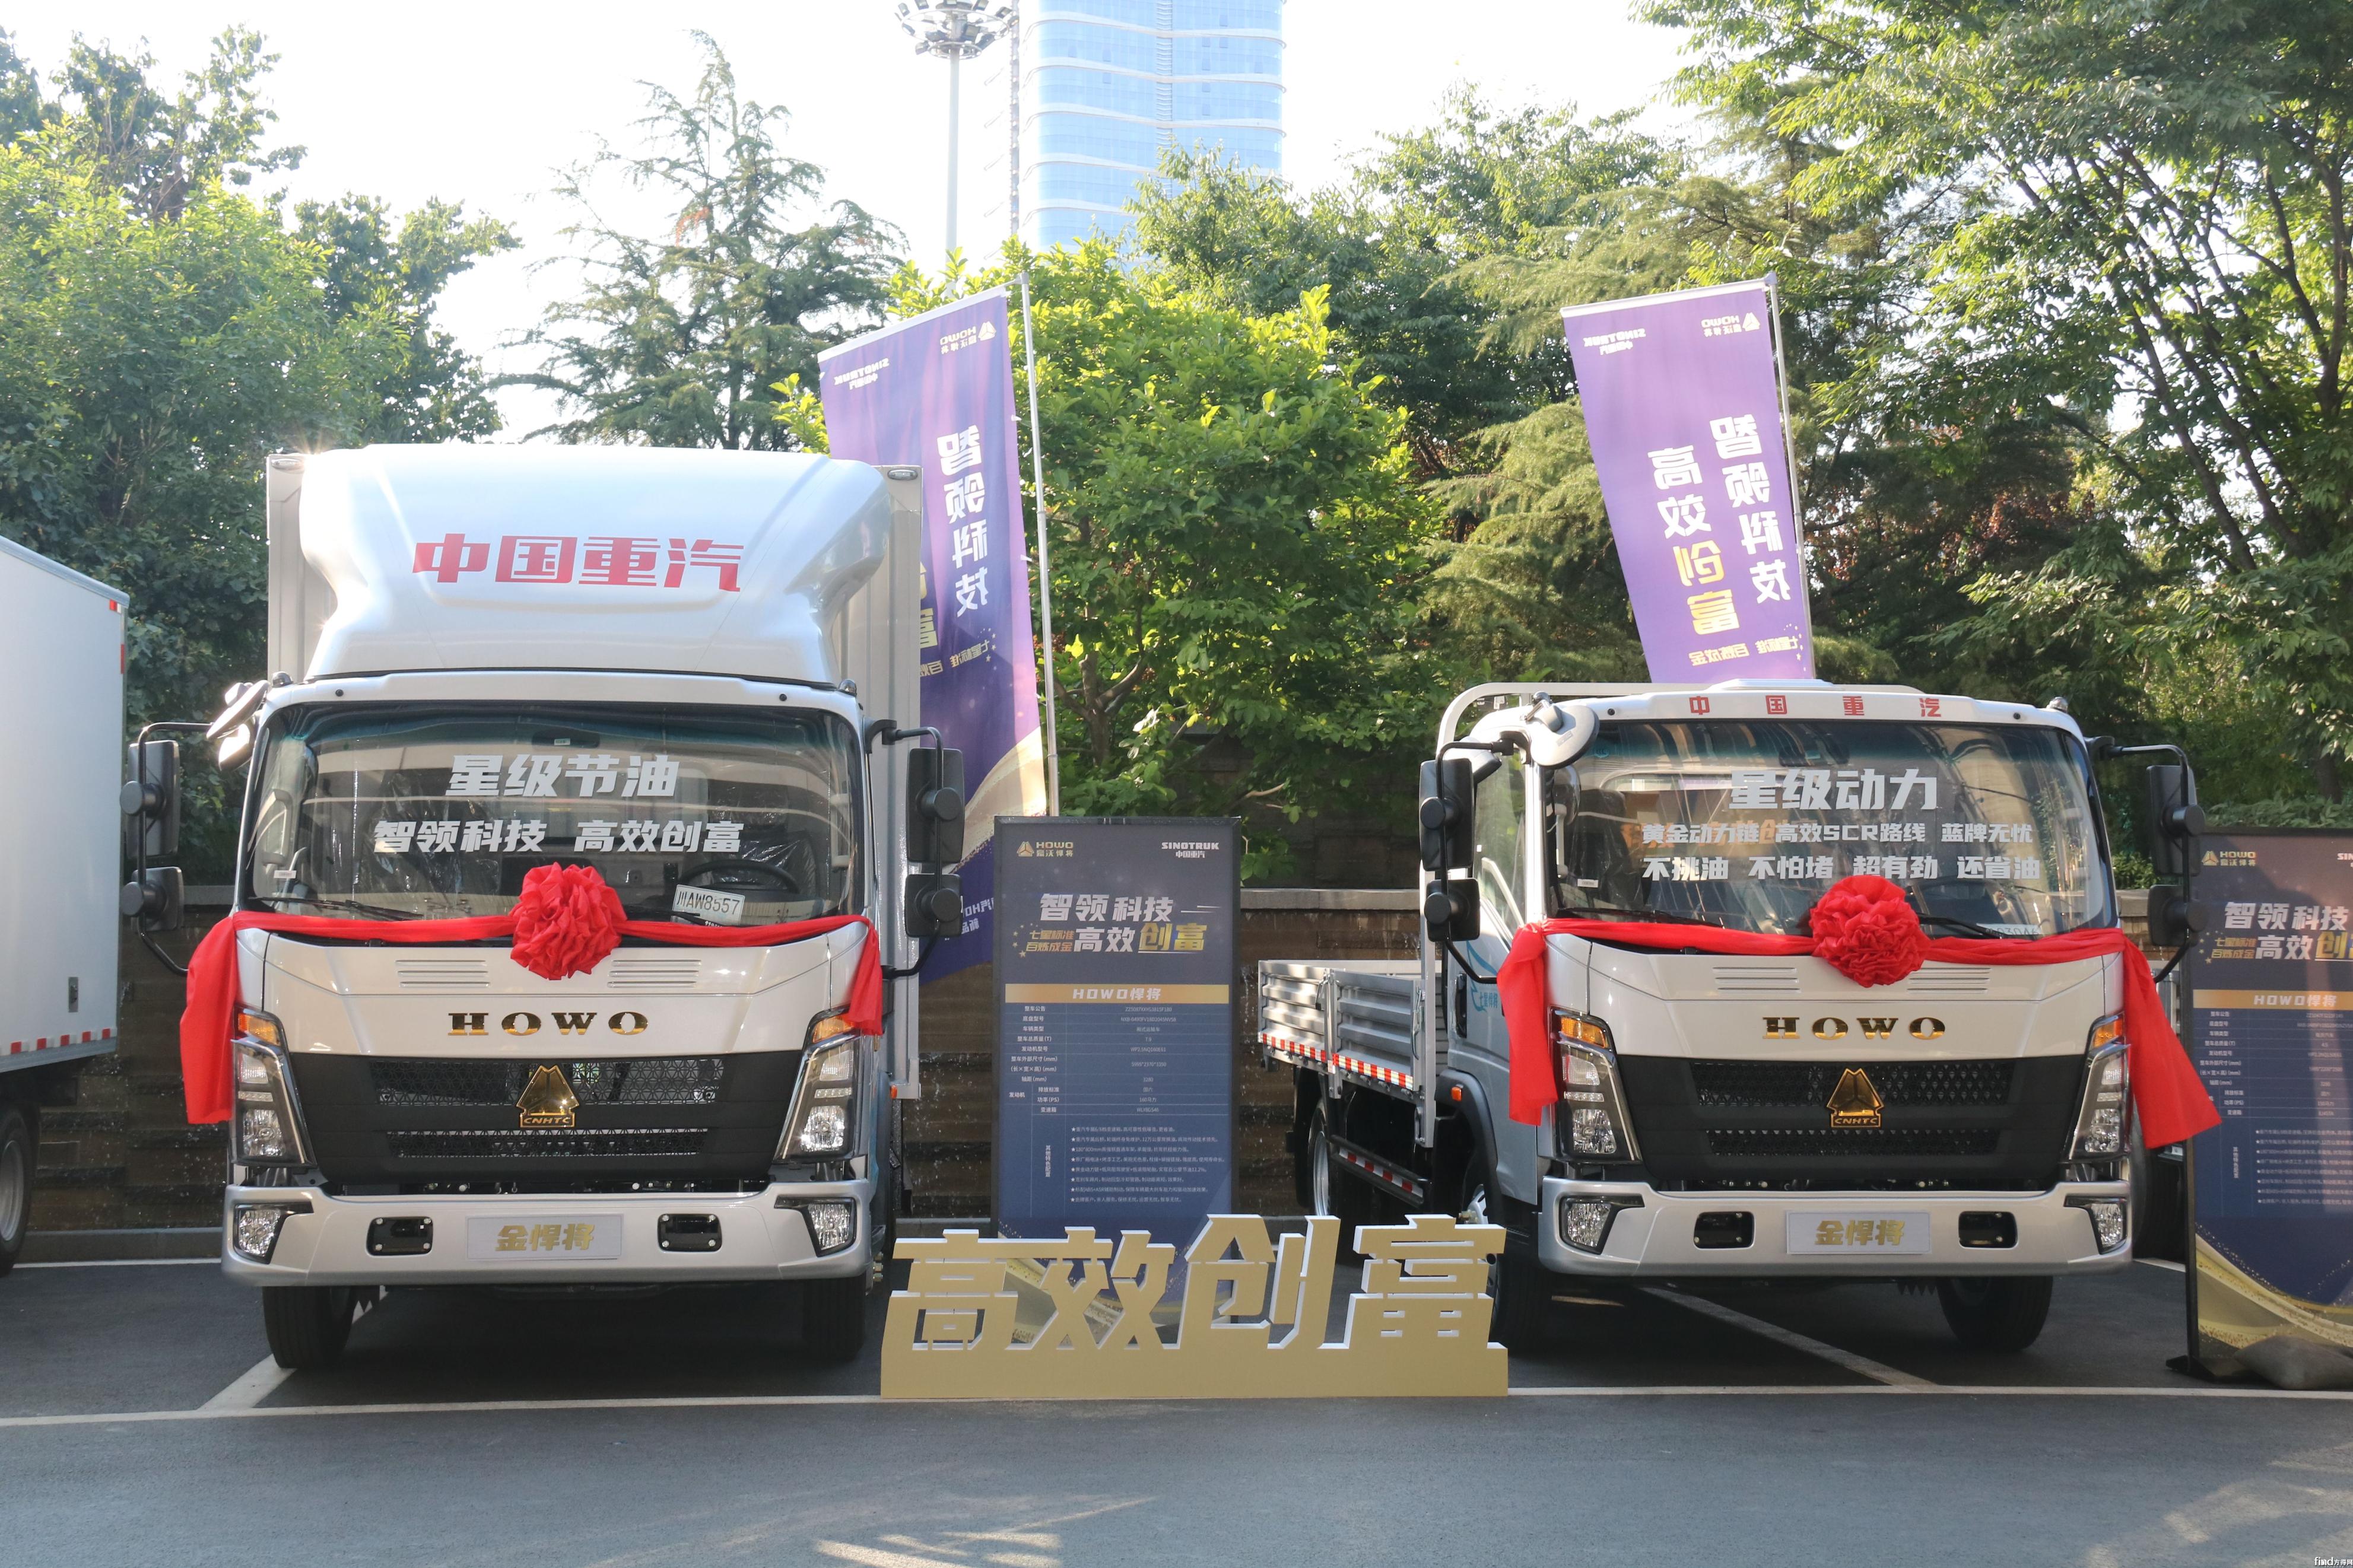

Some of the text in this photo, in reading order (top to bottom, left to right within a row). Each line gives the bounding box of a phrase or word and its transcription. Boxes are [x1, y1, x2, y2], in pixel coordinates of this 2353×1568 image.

[412, 533, 744, 592] 中国重汽
[1690, 695, 1941, 717] 中国重汽
[445, 754, 680, 797] 星级节油
[1729, 768, 1938, 811] 星级动力
[373, 820, 744, 854] 智领科技 高效创富
[1161, 842, 1220, 850] SINOTRUK
[1642, 823, 1759, 844] 黄金动力链
[1775, 823, 1926, 843] 高效SCR路线
[1941, 823, 2033, 842] 蓝牌无忧
[1642, 855, 2040, 881] 不挑油 不怕堵 超有劲 还省油
[1040, 893, 1173, 922] 智领科技
[2225, 902, 2349, 931] 智领科技
[1025, 942, 1073, 952] 百炼成金
[1029, 930, 1075, 940] 七星标准
[1074, 923, 1207, 953] 高效创富
[2255, 931, 2353, 960] 高效创
[1072, 988, 1161, 1001] HOWO悍将
[2253, 994, 2337, 1007] HOWO悍将
[448, 1011, 649, 1035] HOWO
[1763, 1016, 1945, 1039] HOWO
[494, 1224, 594, 1251] 金悍将
[1815, 1219, 1905, 1245] 金悍将
[888, 1213, 1507, 1350] 高效创富
